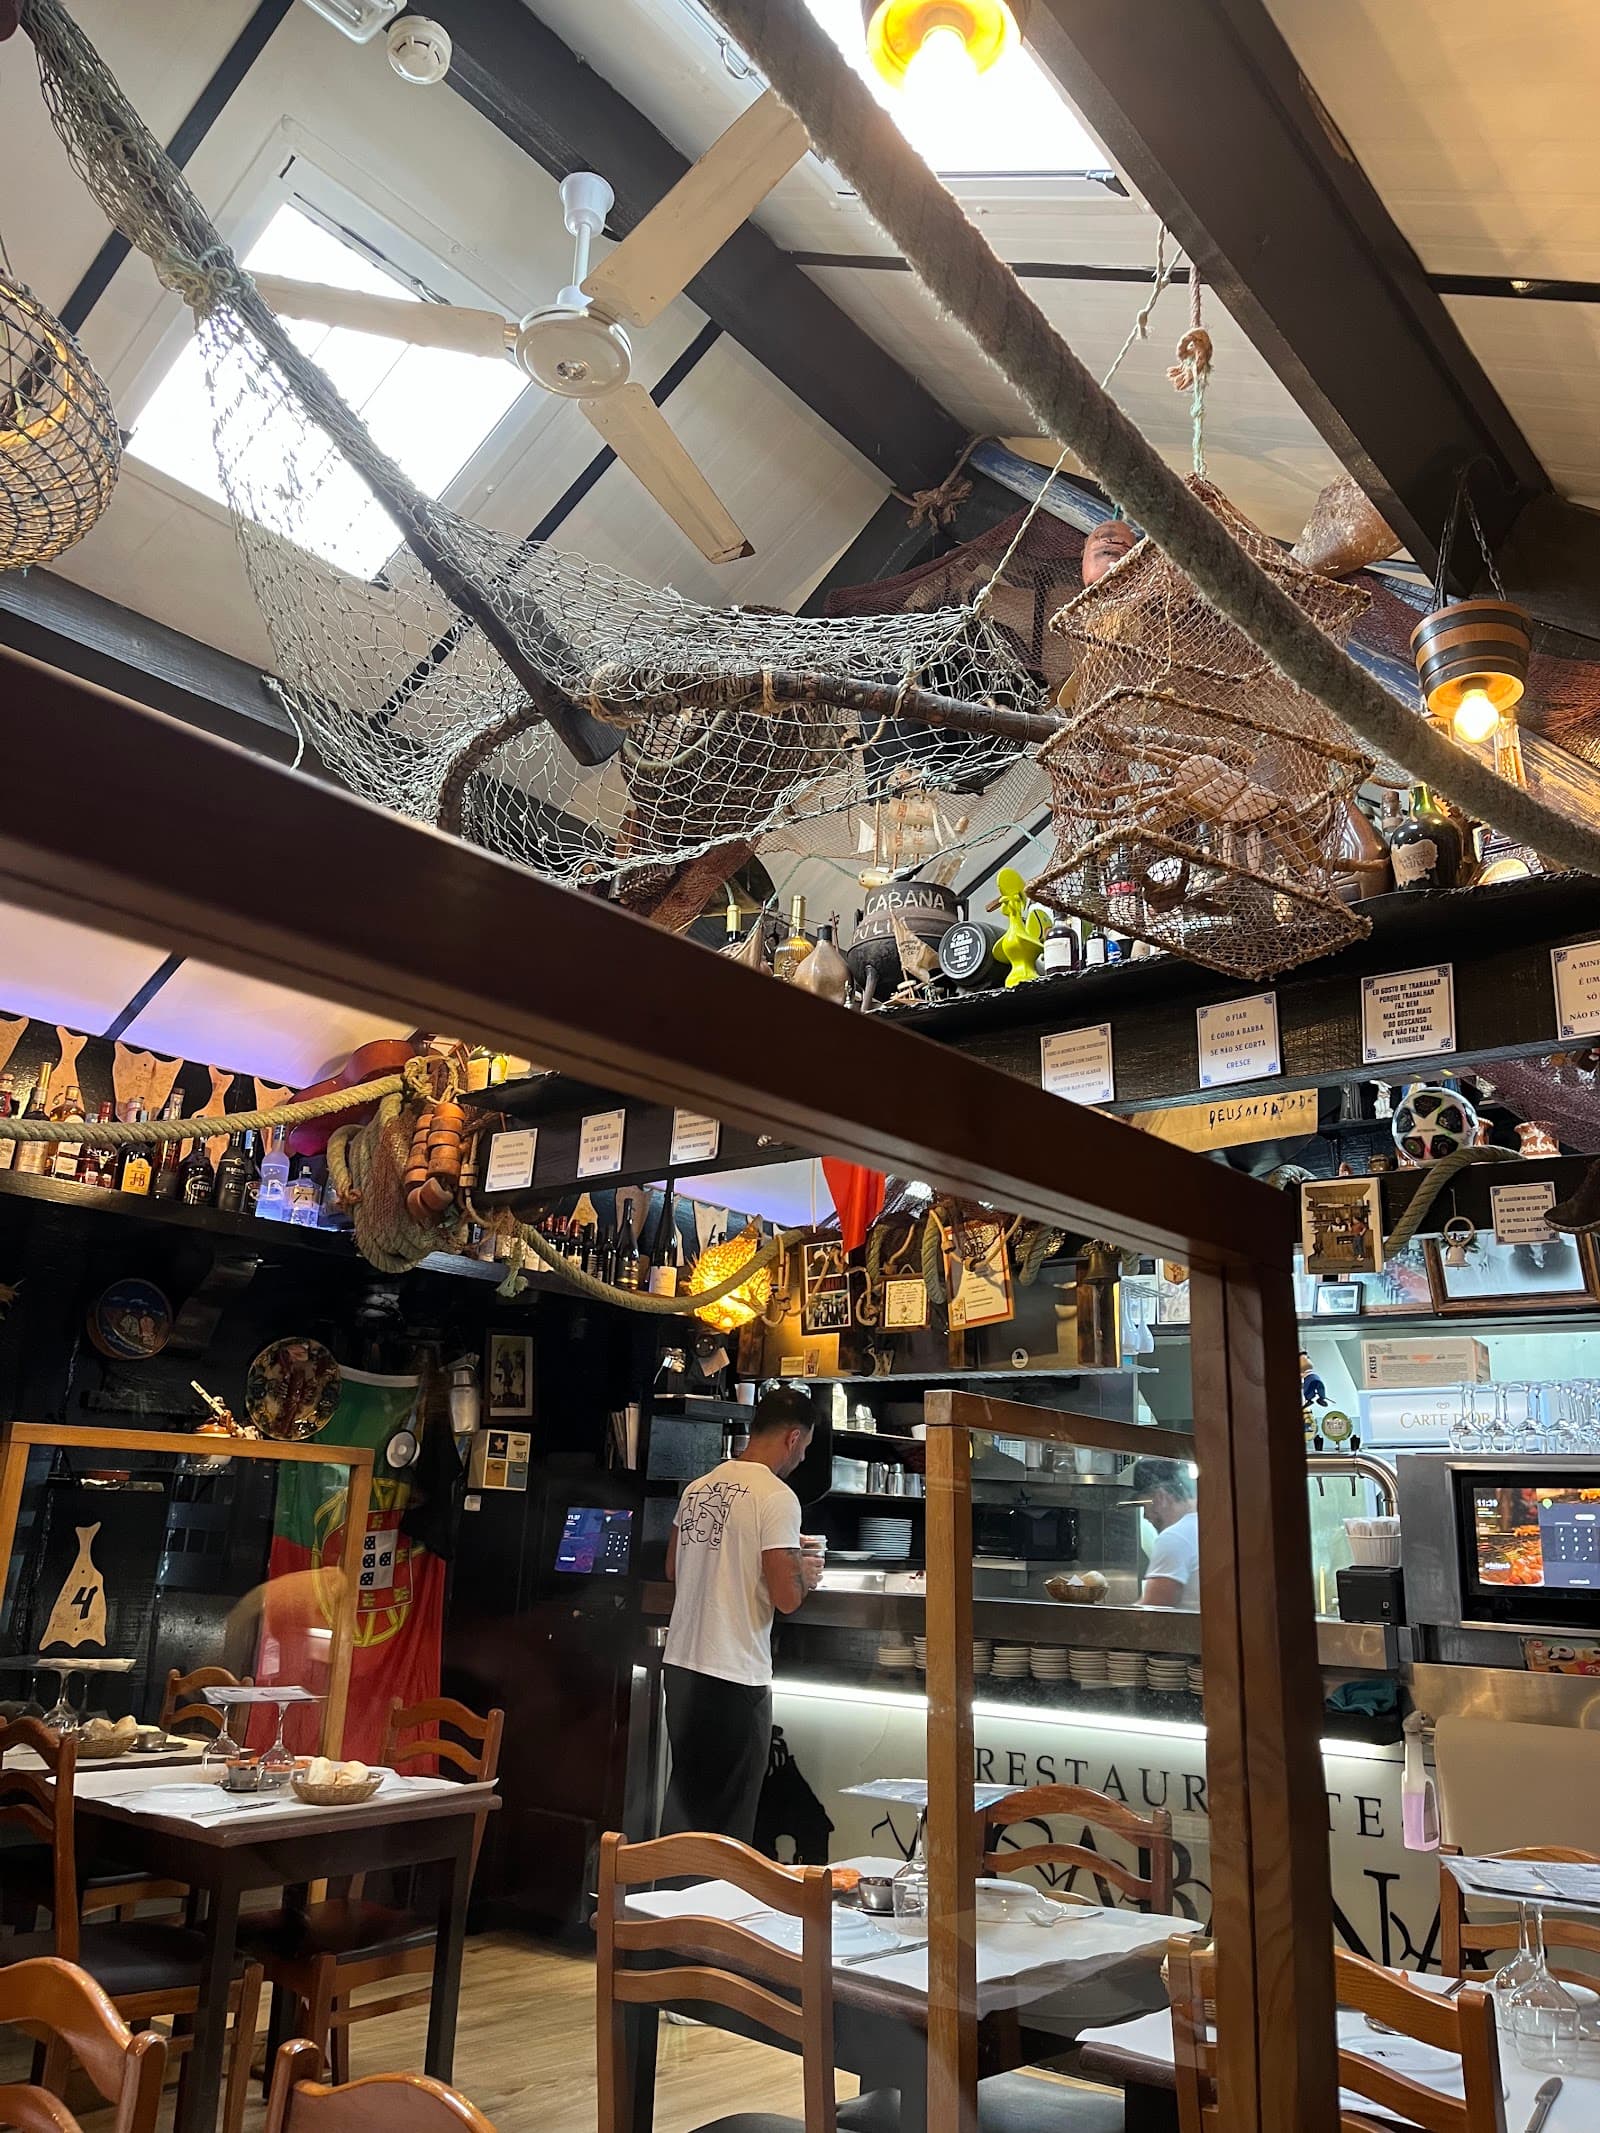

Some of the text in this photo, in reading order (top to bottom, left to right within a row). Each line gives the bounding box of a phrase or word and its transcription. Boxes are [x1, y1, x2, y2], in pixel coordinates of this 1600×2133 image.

[867, 889, 945, 916] CABANA
[1372, 988, 1379, 996] EU
[1380, 985, 1399, 995] GOSTO
[1409, 979, 1441, 990] TRABALHAR
[1379, 989, 1435, 1004] PORQUE TRABALHAR
[1586, 992, 1597, 1001] SÓ
[1395, 1000, 1419, 1010] FAZ BEM
[1232, 1011, 1248, 1021] FIAR
[1383, 1007, 1432, 1020] MAS GOSTO MAIS
[1569, 1012, 1588, 1021] NÃO
[1397, 1016, 1427, 1027] DESCANSO
[1216, 1030, 1235, 1040] COMO
[1242, 1024, 1264, 1034] BARBA
[1383, 1024, 1433, 1039] QUE NÃO FAZ MAL
[1235, 1043, 1243, 1051] SE
[1244, 1039, 1266, 1050] CORTA
[1226, 1058, 1252, 1069] CRESCE
[1400, 1412, 1450, 1429] CARTE
[70, 1585, 98, 1620] 4
